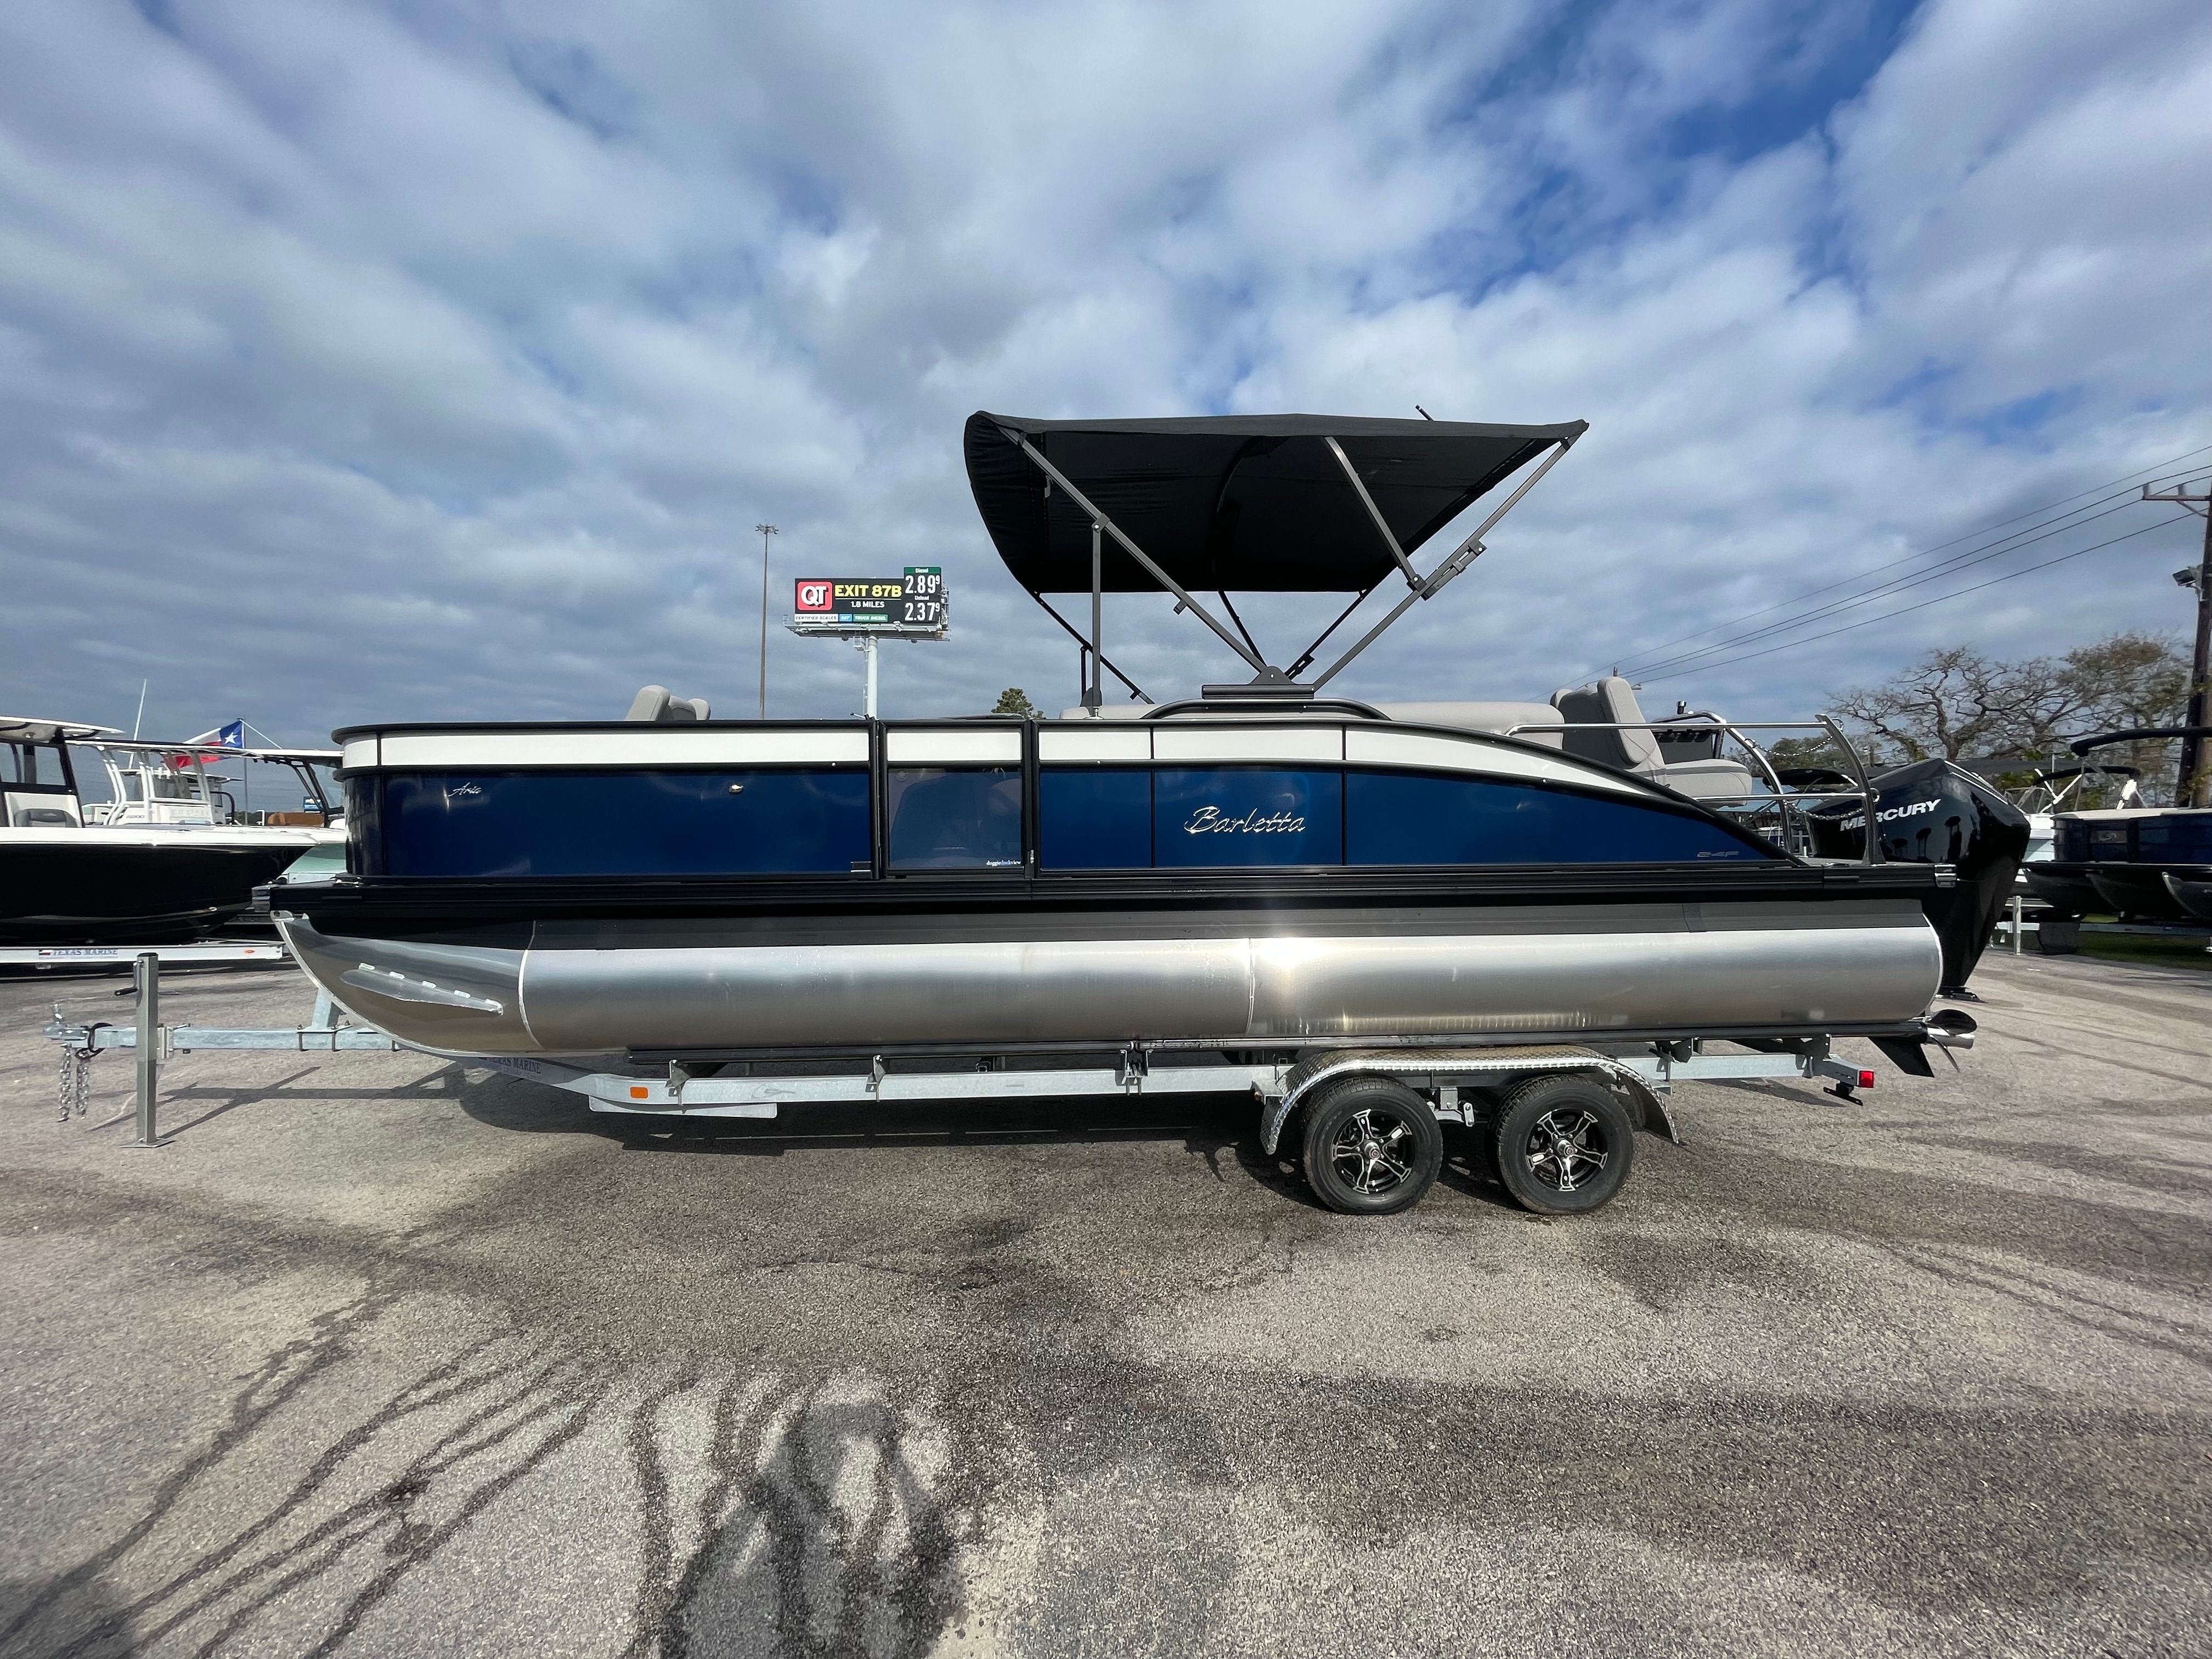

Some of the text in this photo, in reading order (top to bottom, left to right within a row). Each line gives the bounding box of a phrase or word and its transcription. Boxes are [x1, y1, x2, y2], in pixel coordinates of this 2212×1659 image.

[801, 585, 827, 606] QT
[834, 585, 902, 597] EXIT 87B
[1183, 805, 1306, 834] Barletta
[1839, 798, 1942, 831] MERCURY
[513, 1057, 541, 1074] MARINE
